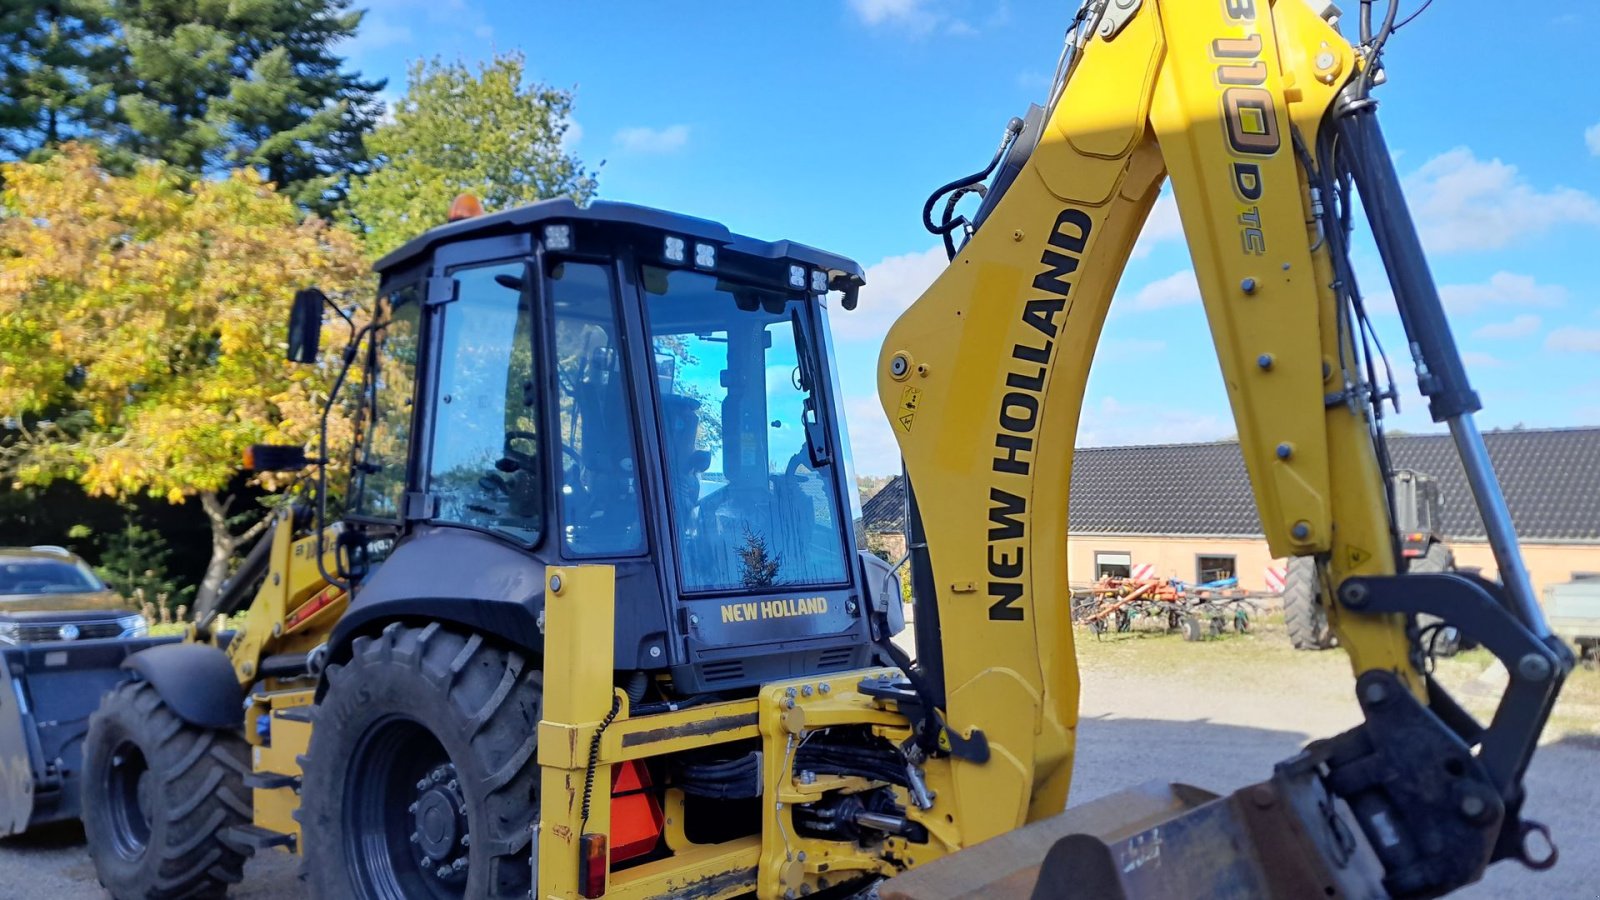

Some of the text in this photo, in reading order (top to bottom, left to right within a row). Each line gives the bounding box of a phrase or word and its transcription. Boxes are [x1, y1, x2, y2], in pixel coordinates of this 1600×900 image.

[987, 207, 1093, 621] NEW HOLLAND
[720, 597, 828, 624] NEW HOLLAND
